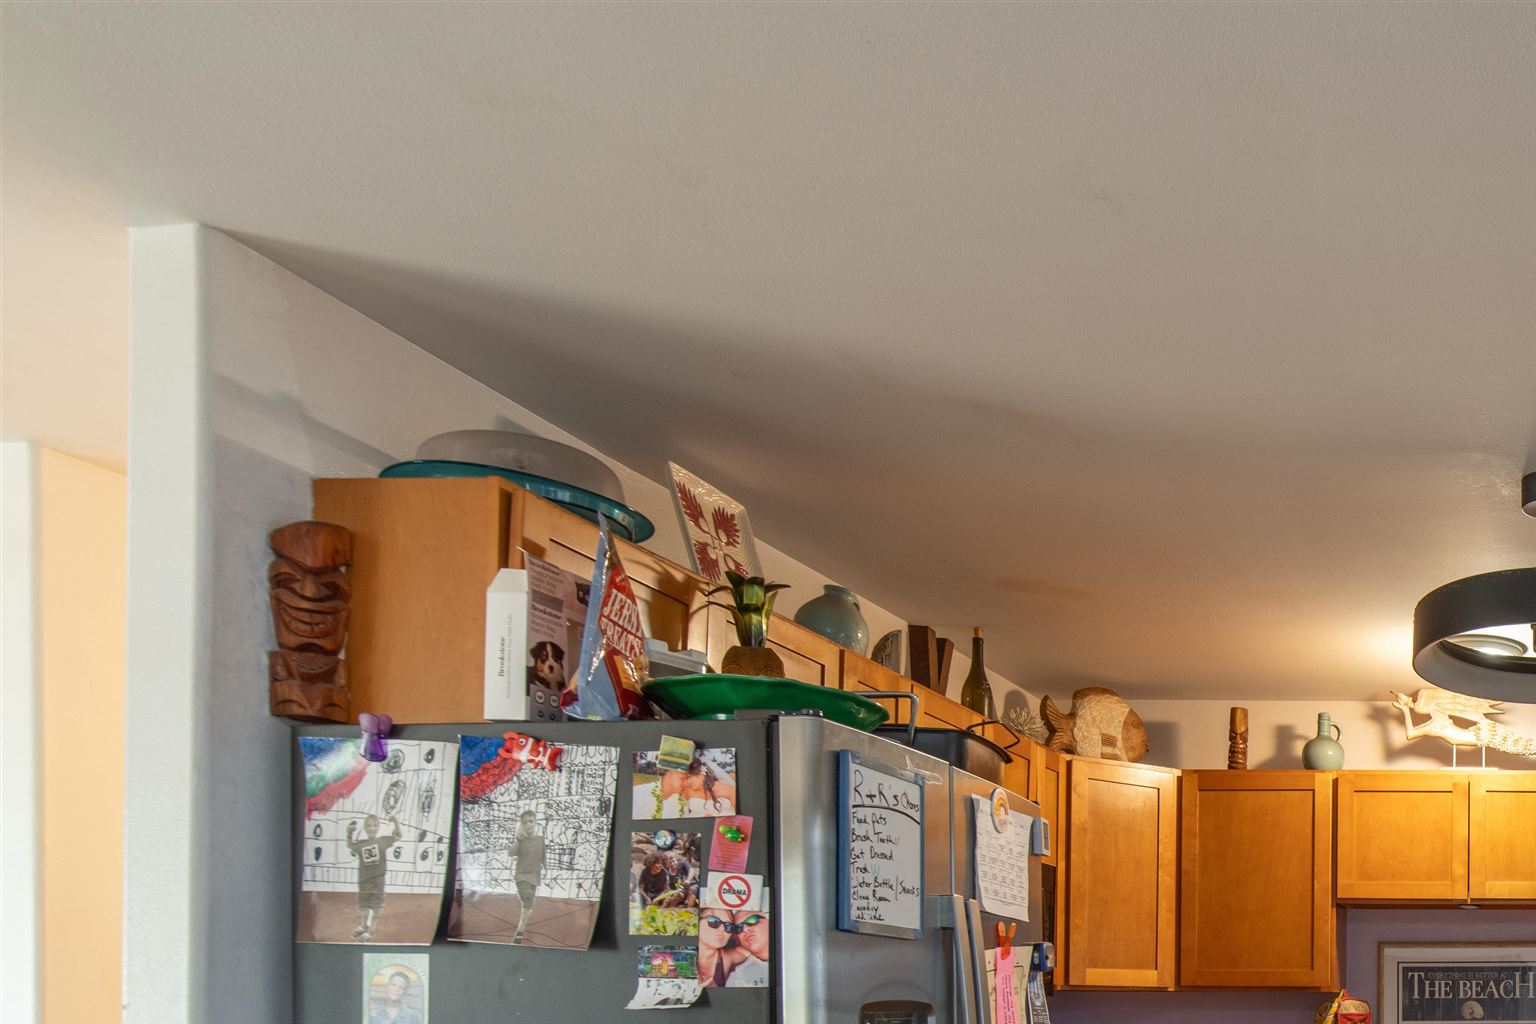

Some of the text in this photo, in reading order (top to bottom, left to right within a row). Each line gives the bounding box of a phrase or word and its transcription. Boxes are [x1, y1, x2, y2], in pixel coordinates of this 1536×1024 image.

[498, 636, 506, 677] Brookstone
[722, 887, 747, 897] DRAMA
[1407, 971, 1536, 999] THE BEACH
